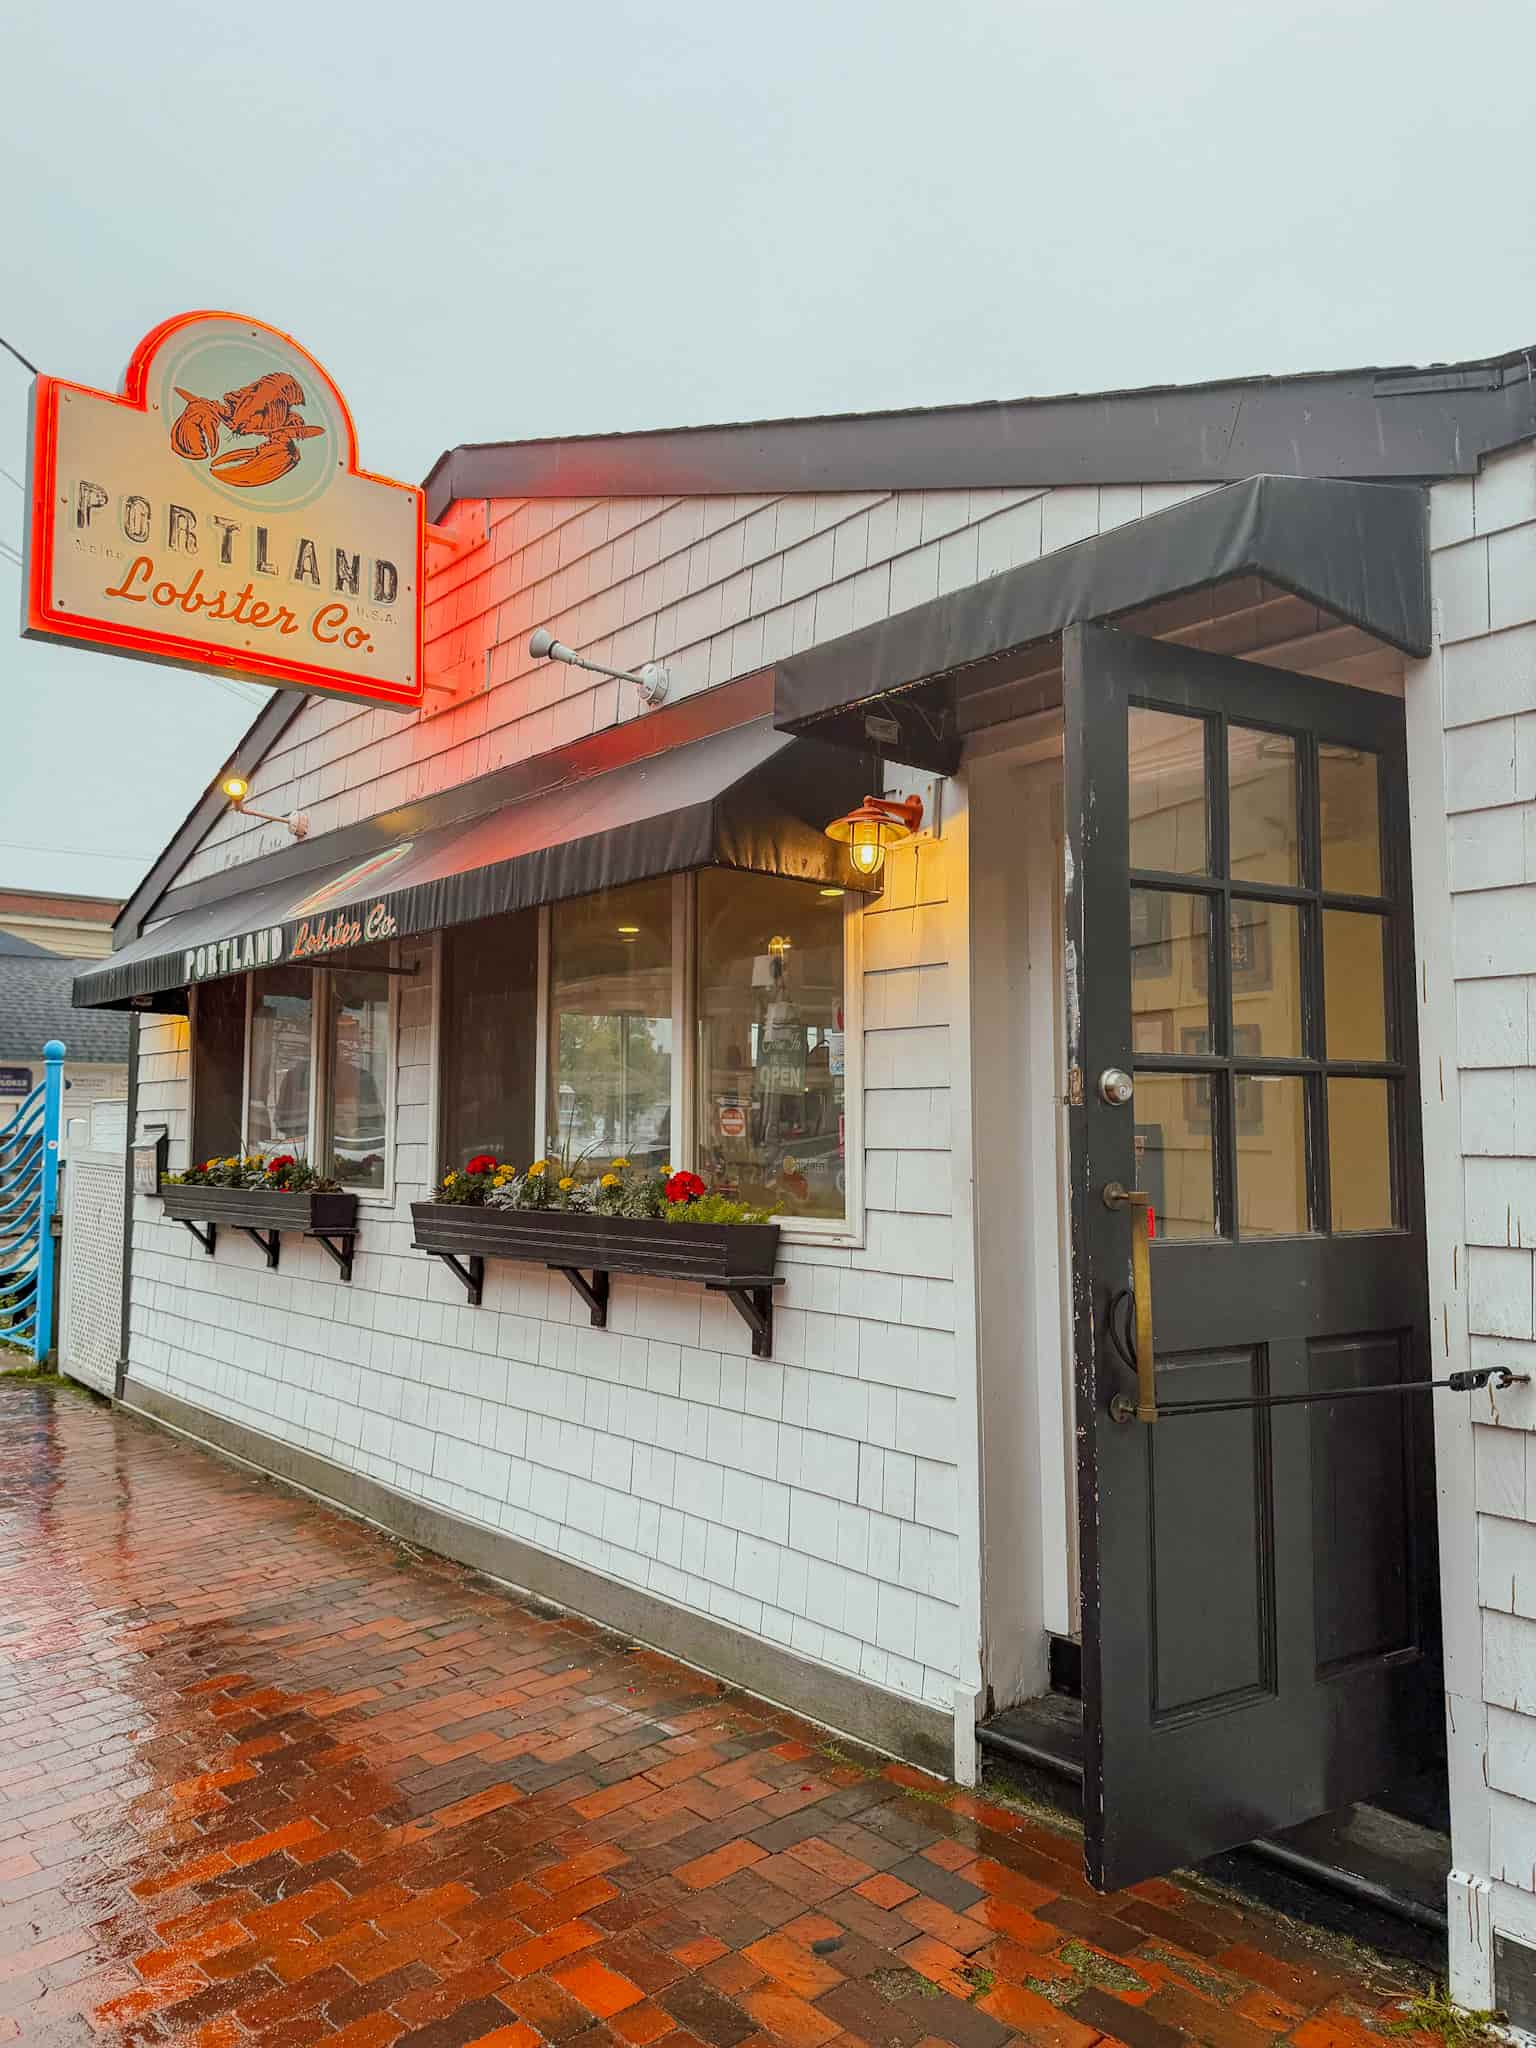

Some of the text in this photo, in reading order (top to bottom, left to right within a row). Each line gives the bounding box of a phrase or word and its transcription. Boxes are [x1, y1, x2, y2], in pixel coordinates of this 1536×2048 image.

[76, 480, 398, 603] PORTLAND
[105, 556, 374, 653] Lobster Co.
[184, 904, 397, 982] PORTLAND Lobster Co.
[760, 1065, 801, 1088] OPEN
